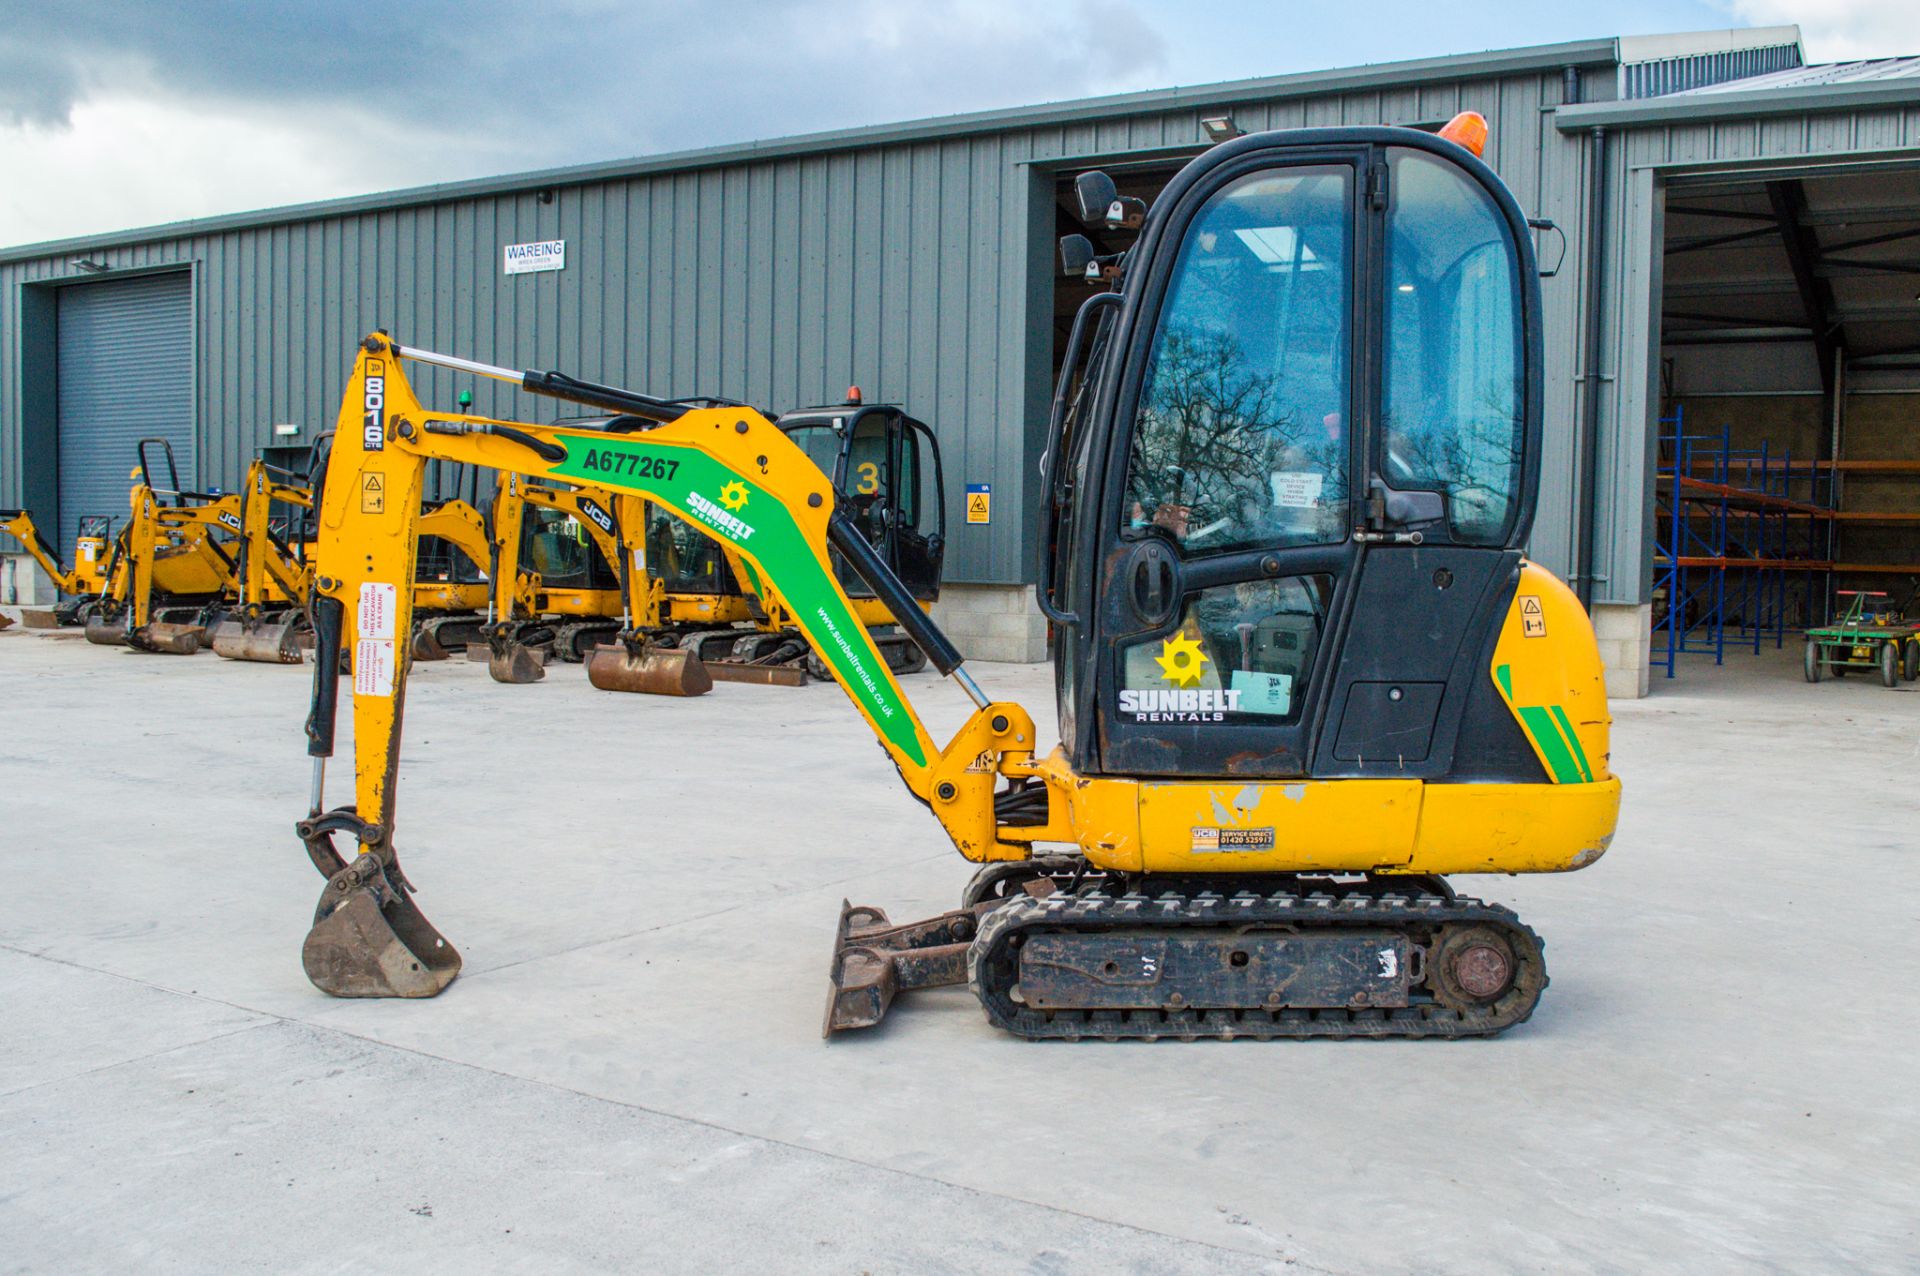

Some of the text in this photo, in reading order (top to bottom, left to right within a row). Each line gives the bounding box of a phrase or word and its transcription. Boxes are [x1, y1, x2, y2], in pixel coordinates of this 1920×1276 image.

[508, 242, 562, 259] WAREING
[365, 377, 384, 442] 8016
[583, 449, 680, 481] A677267
[857, 462, 878, 495] 3
[583, 501, 612, 531] JCB
[686, 491, 755, 540] SUNBELT
[691, 507, 739, 541] RENTALS
[363, 619, 369, 630] DO
[817, 606, 893, 718] www.sunbeltrentals.co.uk
[1119, 690, 1241, 711] SUNBELT
[1136, 712, 1224, 722] RENTALS
[1193, 829, 1217, 837] JCB
